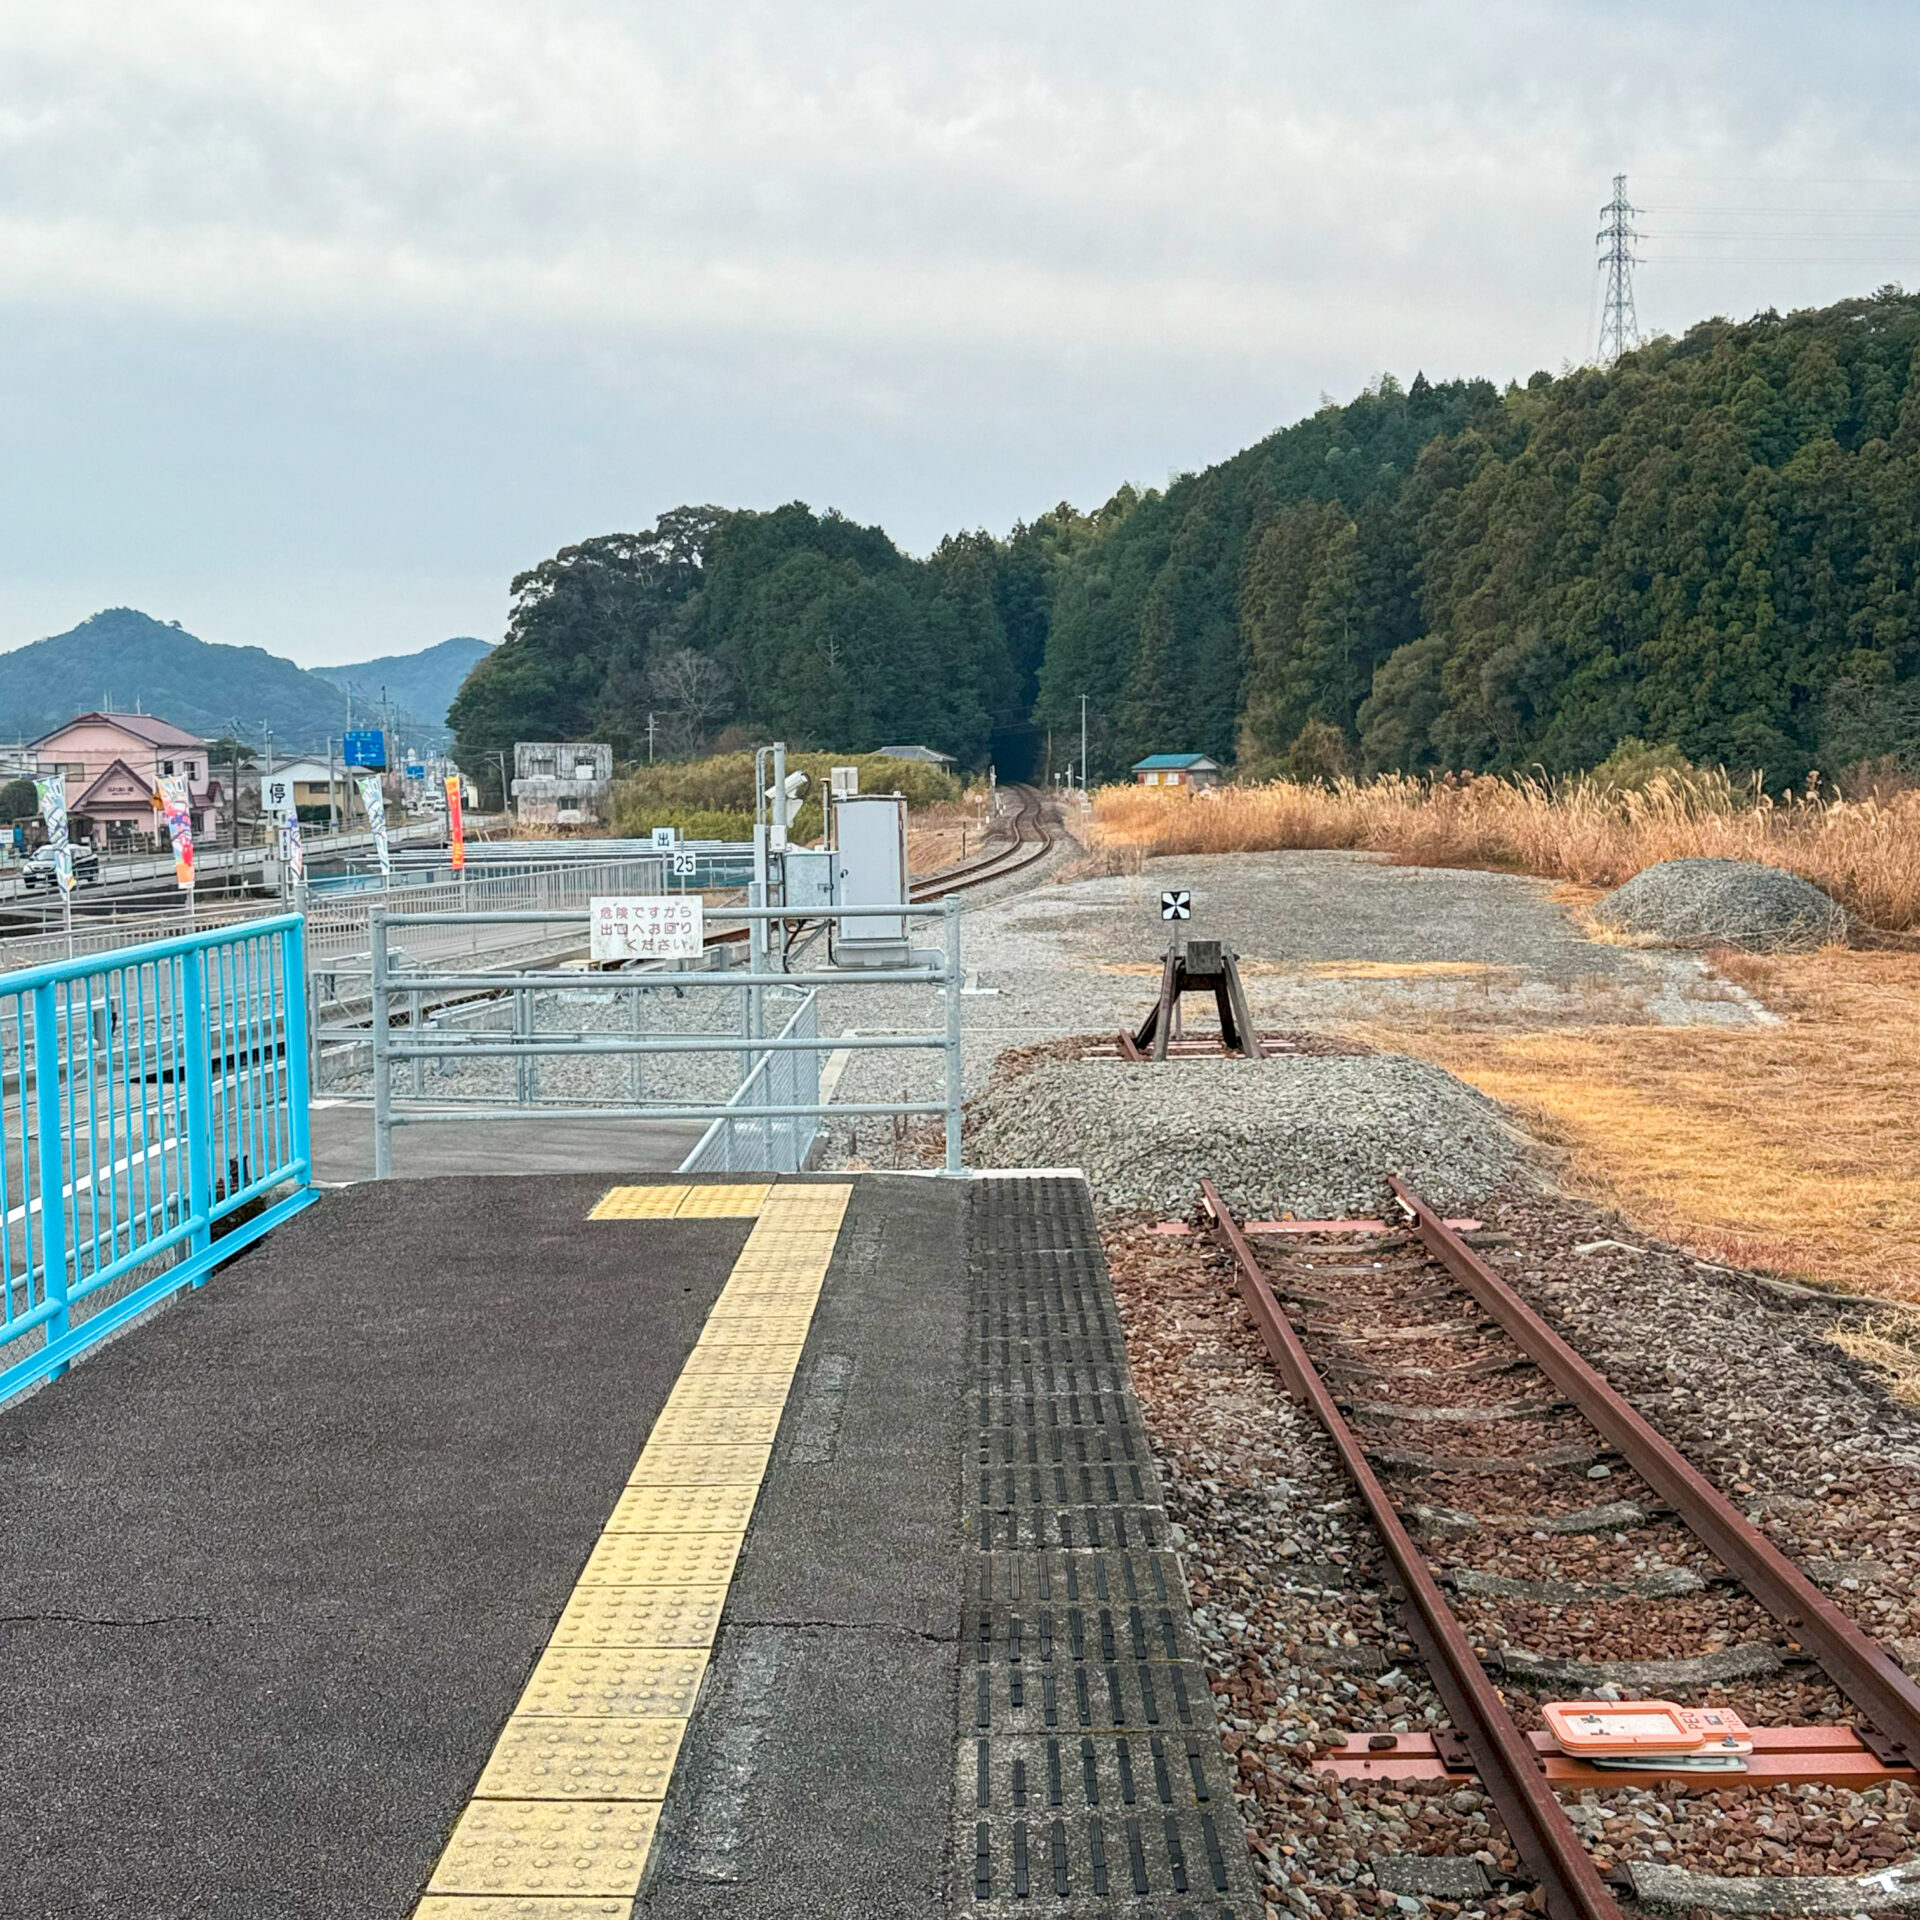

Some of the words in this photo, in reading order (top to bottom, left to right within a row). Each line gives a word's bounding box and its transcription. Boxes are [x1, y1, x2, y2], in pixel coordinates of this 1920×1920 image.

[269, 783, 286, 804] 停
[658, 832, 670, 847] 出
[676, 855, 694, 873] 25
[600, 906, 692, 920] 危険ですから
[600, 922, 692, 936] 出口へお回り
[626, 939, 695, 952] ください。
